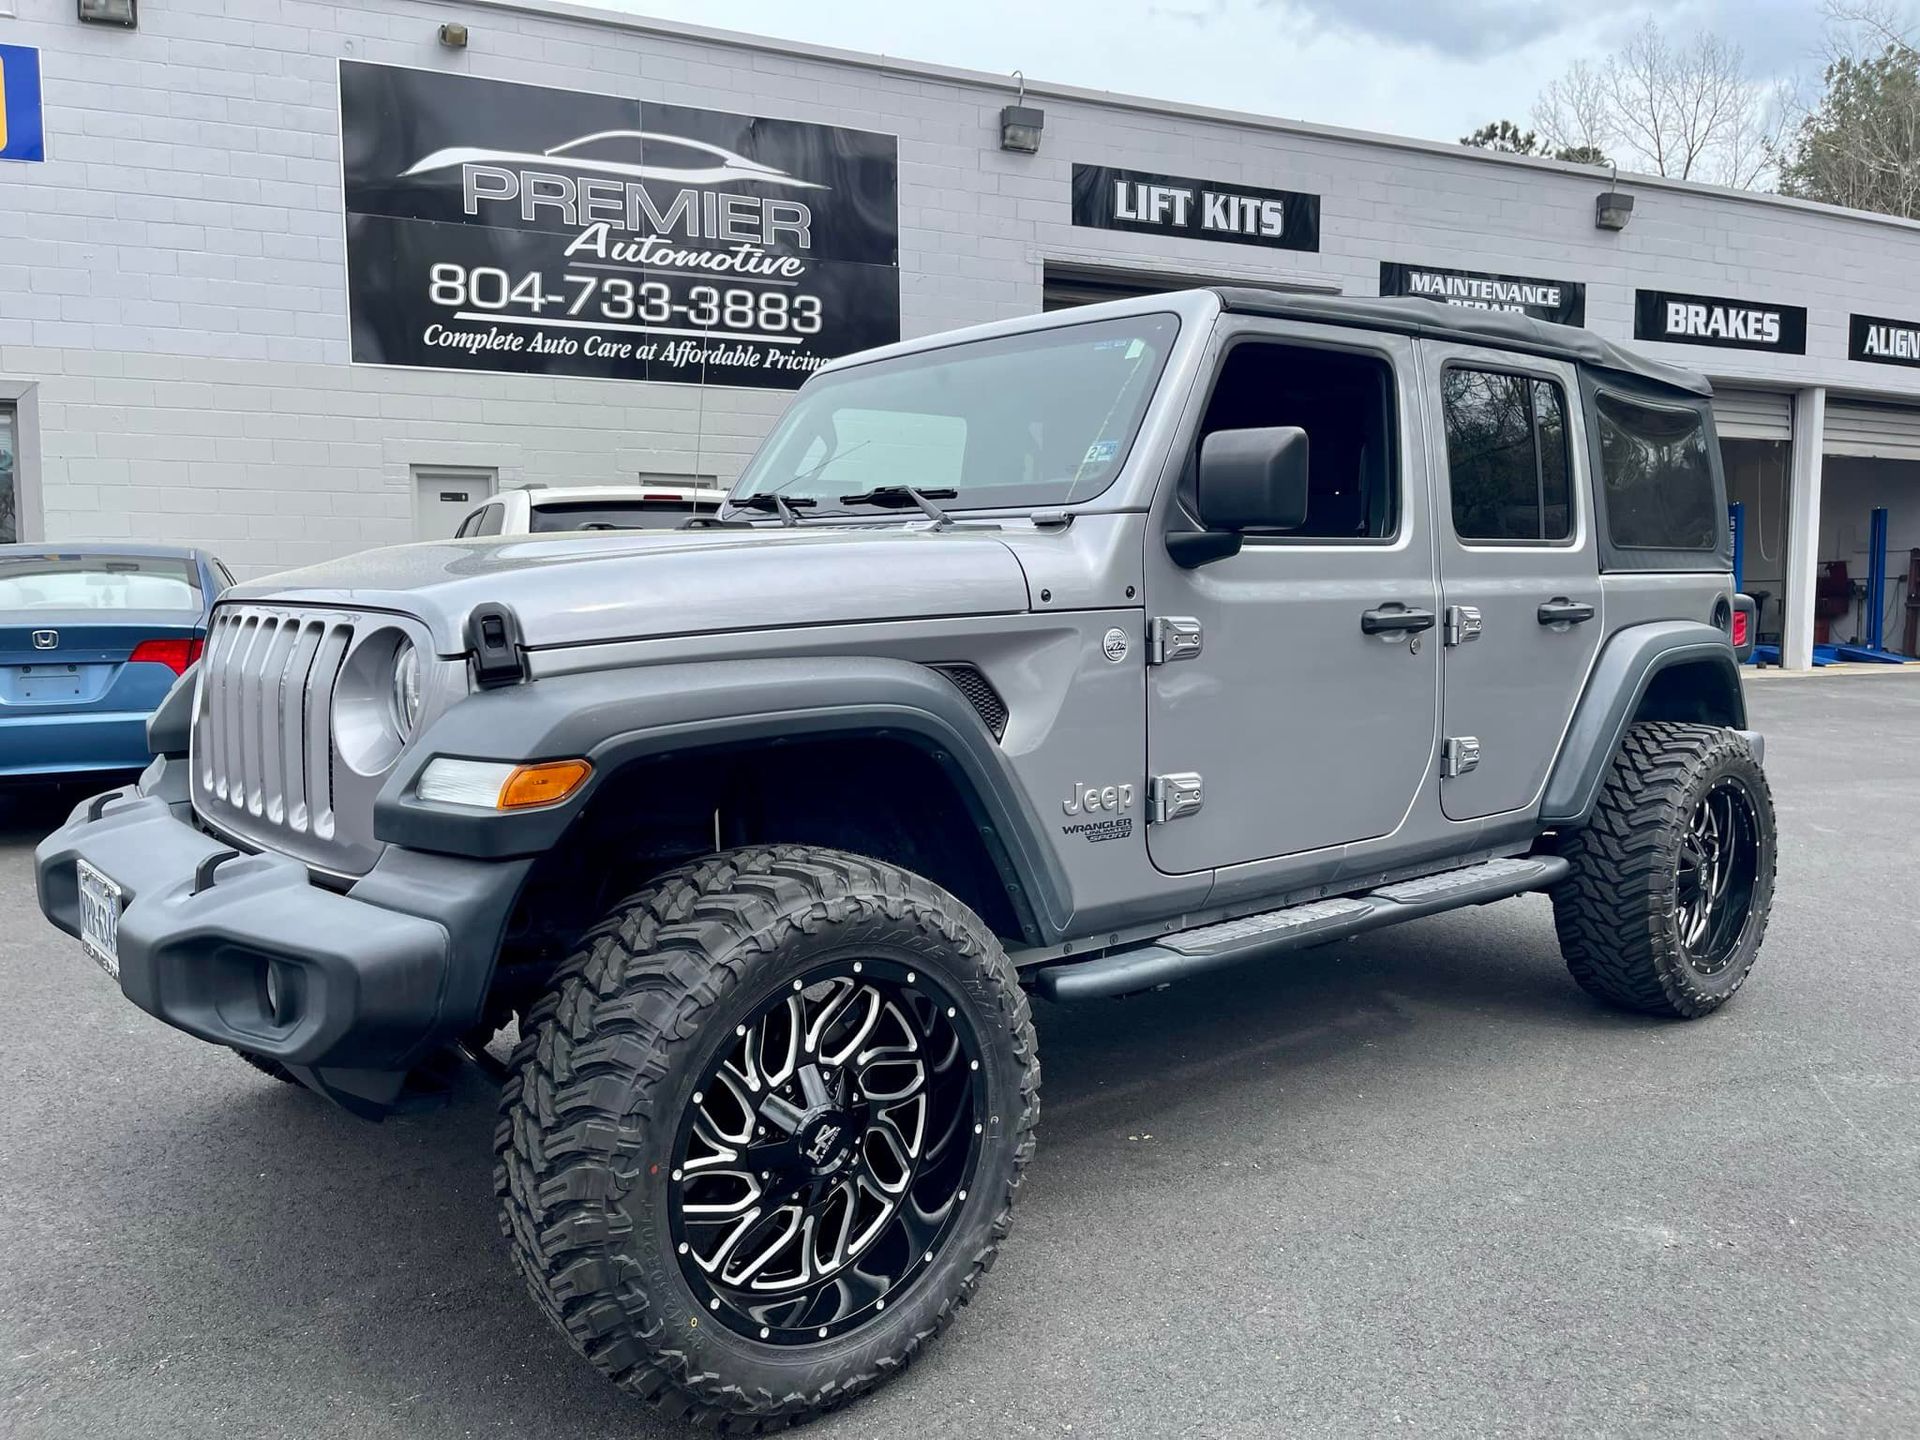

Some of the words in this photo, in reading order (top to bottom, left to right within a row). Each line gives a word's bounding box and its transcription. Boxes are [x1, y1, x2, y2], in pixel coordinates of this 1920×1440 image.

[462, 163, 812, 249] PREMIER
[1114, 179, 1193, 227] LIFT
[1201, 190, 1285, 239] KITS
[564, 221, 806, 278] Automotive
[428, 261, 824, 334] 804-733-3883
[1410, 271, 1560, 307] MAINTENANCE
[1666, 302, 1780, 343] BRAKES
[1863, 325, 1920, 359] ALIGN
[423, 323, 524, 358] Complete
[527, 330, 579, 356] Auto
[583, 335, 633, 360] Care
[635, 341, 657, 361] at
[659, 340, 761, 369] Affordable
[1063, 782, 1134, 816] Jeep
[1062, 817, 1132, 835] WRANGLER
